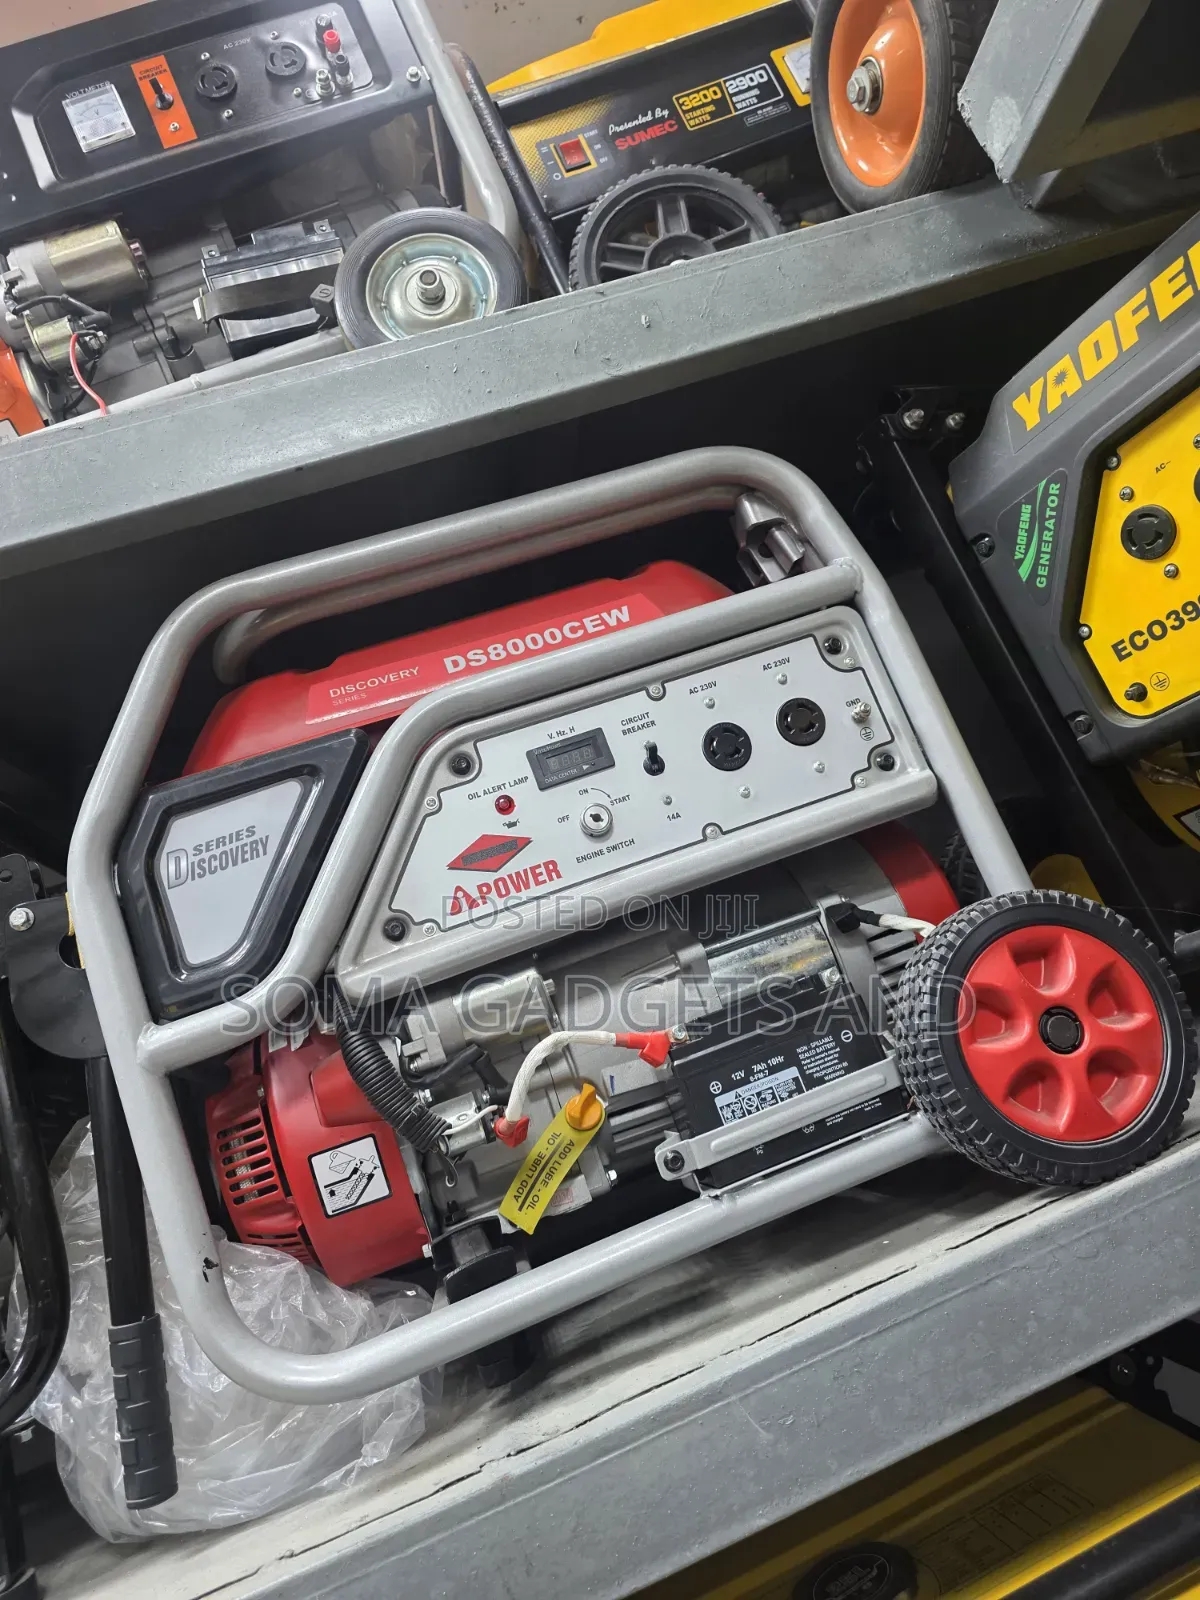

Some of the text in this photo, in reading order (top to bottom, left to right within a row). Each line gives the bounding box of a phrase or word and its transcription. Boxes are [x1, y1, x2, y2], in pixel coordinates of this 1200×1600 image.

[223, 37, 251, 50] AC 230V
[138, 68, 168, 81] BREAKER
[139, 64, 163, 75] CIRCUIT
[65, 80, 111, 99] VOLTMETER
[726, 69, 769, 94] 2900
[678, 86, 722, 111] 3200
[735, 97, 758, 110] WATTS
[685, 104, 716, 119] STARTING
[608, 107, 669, 135] Presented By
[688, 114, 711, 127] WATTS
[615, 119, 679, 150] SUMEC
[1014, 503, 1032, 560] YAOFENG
[1036, 482, 1061, 588] GENERATOR
[1111, 594, 1200, 663] ECO39
[443, 605, 630, 675] DS8000CEW
[762, 656, 791, 671] AC 230V
[329, 666, 420, 698] DISCOVERY
[688, 680, 718, 695] AC 230V
[332, 691, 367, 706] SERIES
[845, 697, 861, 707] GND
[620, 711, 650, 727] CIRCUIT
[569, 726, 576, 734] H
[622, 720, 657, 736] BREAKER
[467, 775, 529, 801] OIL ALERT LAMP
[578, 788, 589, 796] ON
[609, 794, 631, 806] START
[557, 814, 570, 824] OFF
[666, 811, 682, 822] 14A
[192, 825, 256, 857] SERIES
[575, 838, 636, 864] ENGINE SWITCH
[167, 834, 270, 890] DISCOVERY
[816, 1042, 836, 1053] BATTERY
[731, 1055, 784, 1081] 12V 7Ah 10Hr
[558, 1138, 575, 1160] ADD
[513, 1179, 529, 1203] ADD
[526, 1151, 547, 1179] LUBE
[547, 1131, 562, 1146] OIL
[540, 1159, 562, 1188] LUBE
[526, 1194, 540, 1211] OIL
